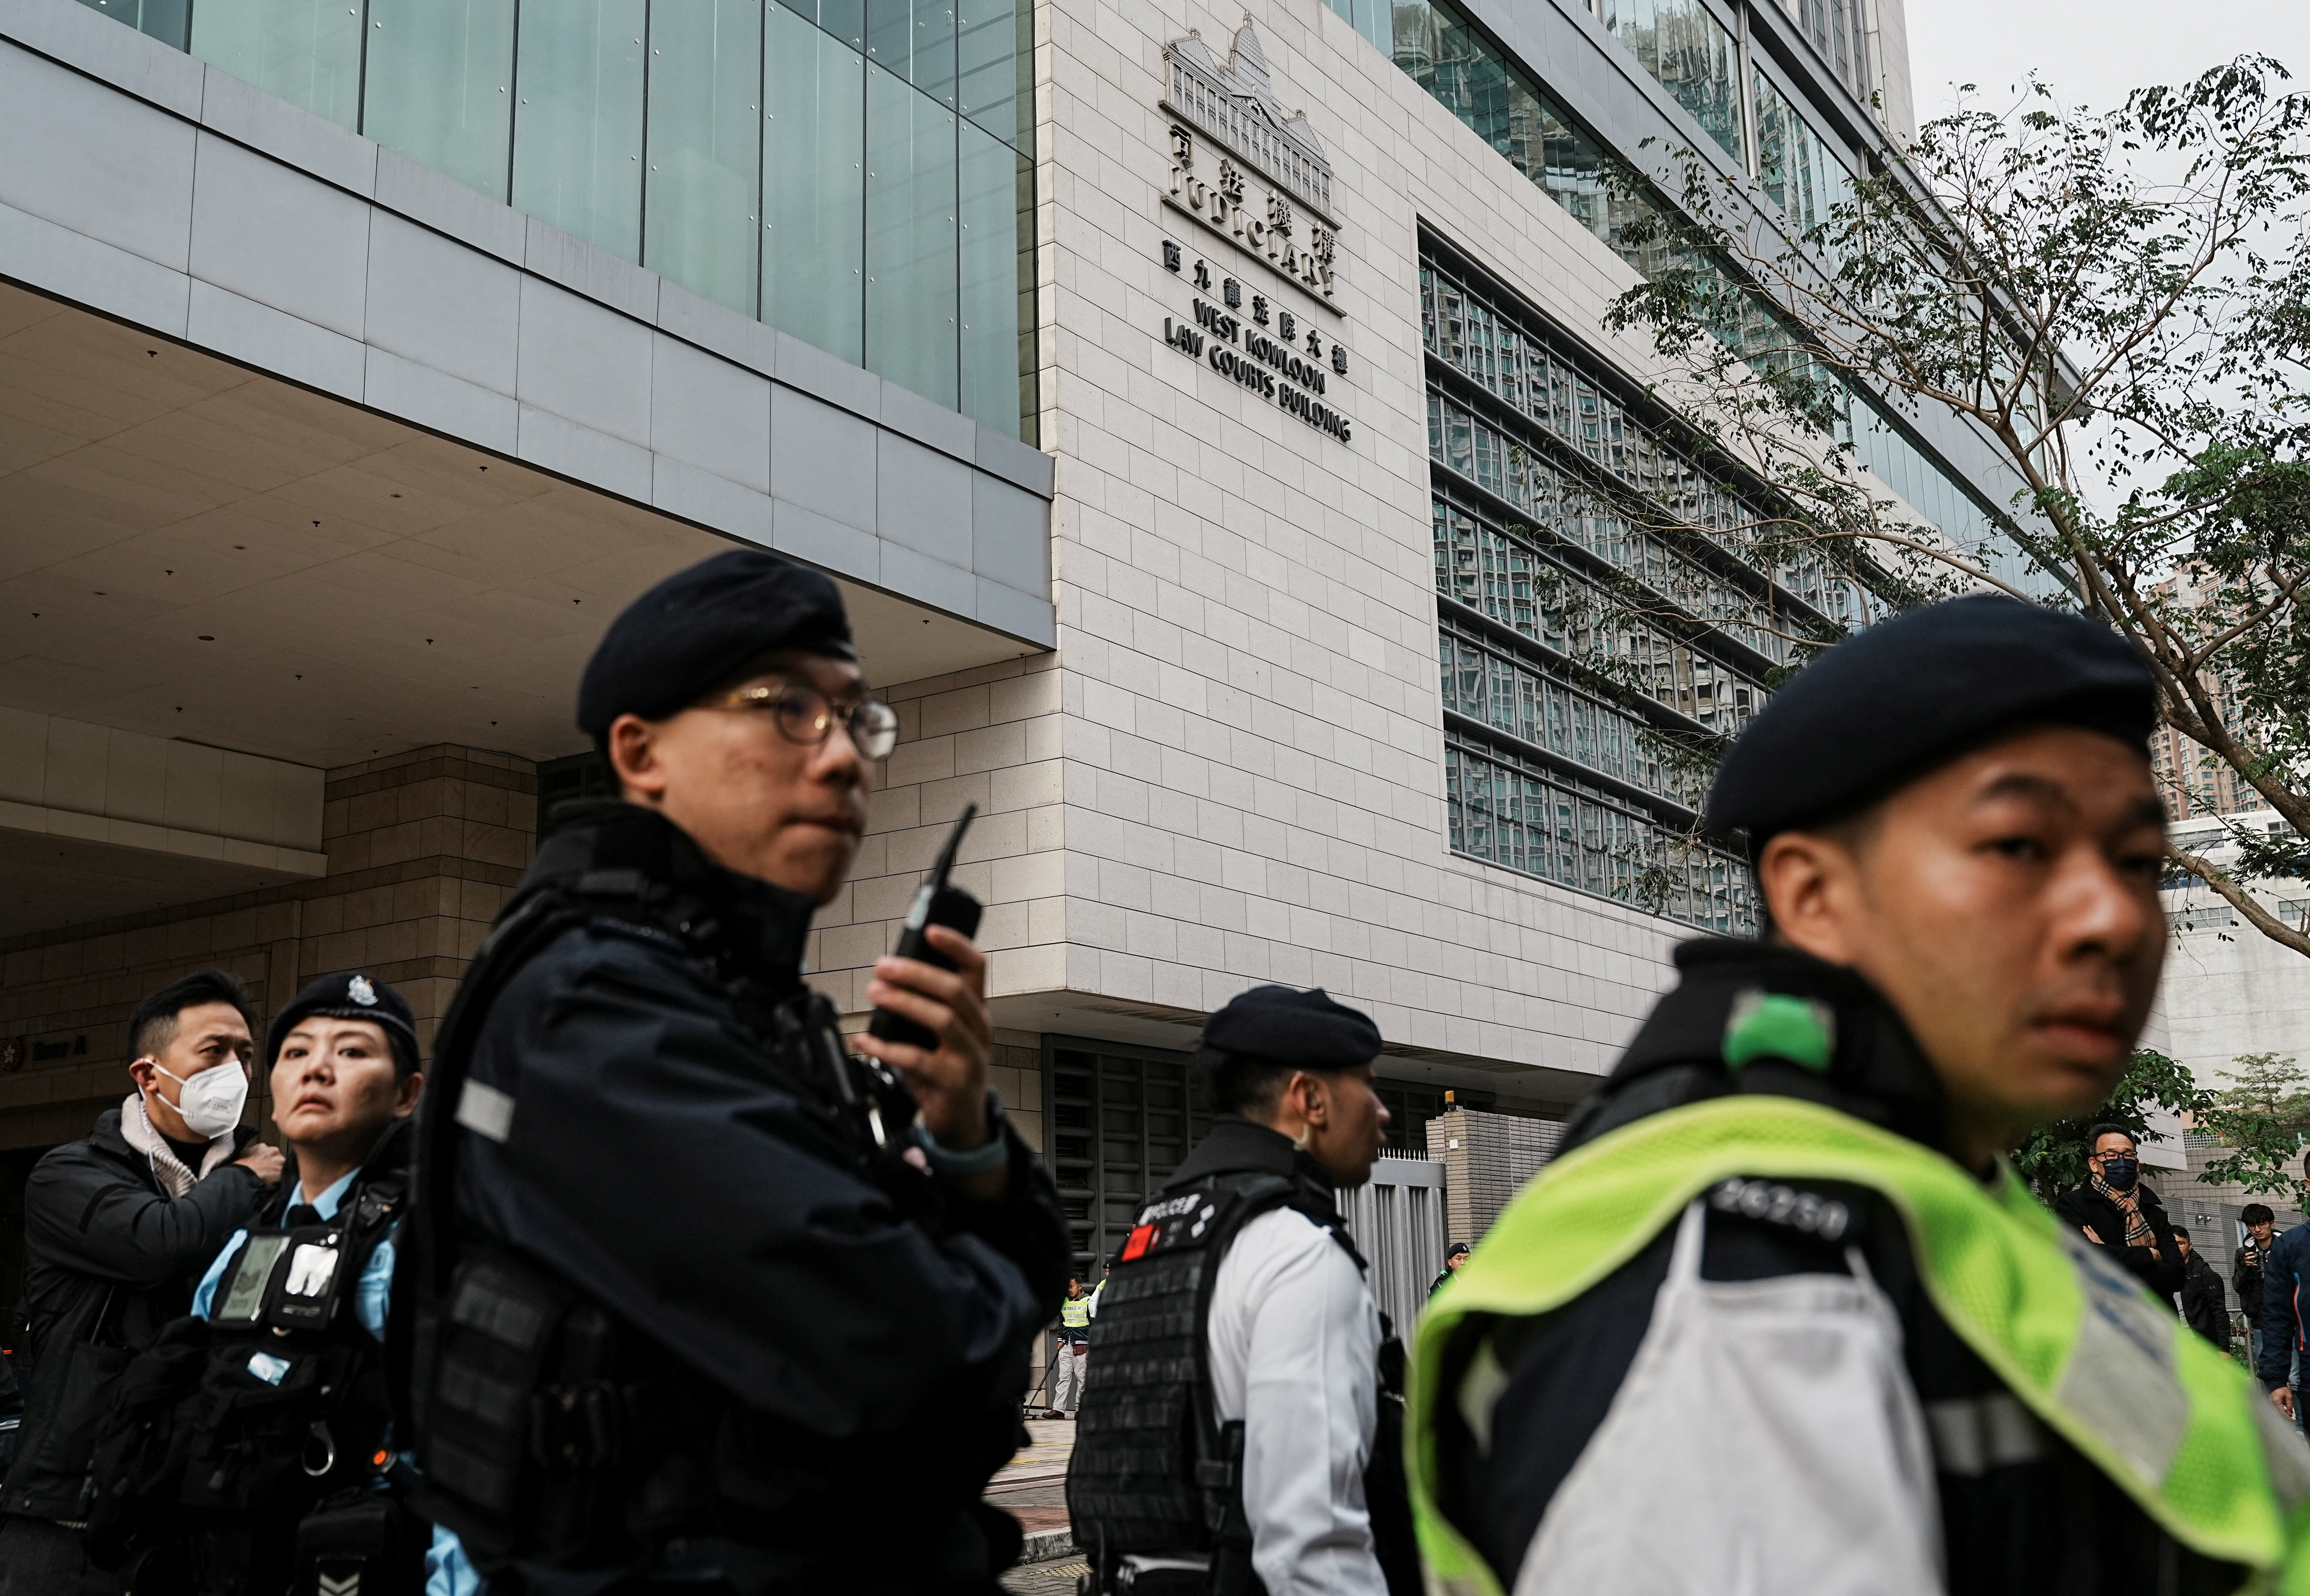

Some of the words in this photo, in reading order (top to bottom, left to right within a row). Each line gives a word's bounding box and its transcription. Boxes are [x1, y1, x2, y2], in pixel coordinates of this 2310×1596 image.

[1169, 123, 1336, 265] 司法機構
[1171, 167, 1336, 295] JUDICIARY
[1163, 239, 1348, 374] 西九龍法院大樓
[1193, 298, 1241, 343] WEST
[1245, 329, 1326, 395] KOWLOON
[1165, 317, 1205, 358] LAW
[1209, 345, 1276, 397] COURTS
[1279, 383, 1351, 442] BUILDING
